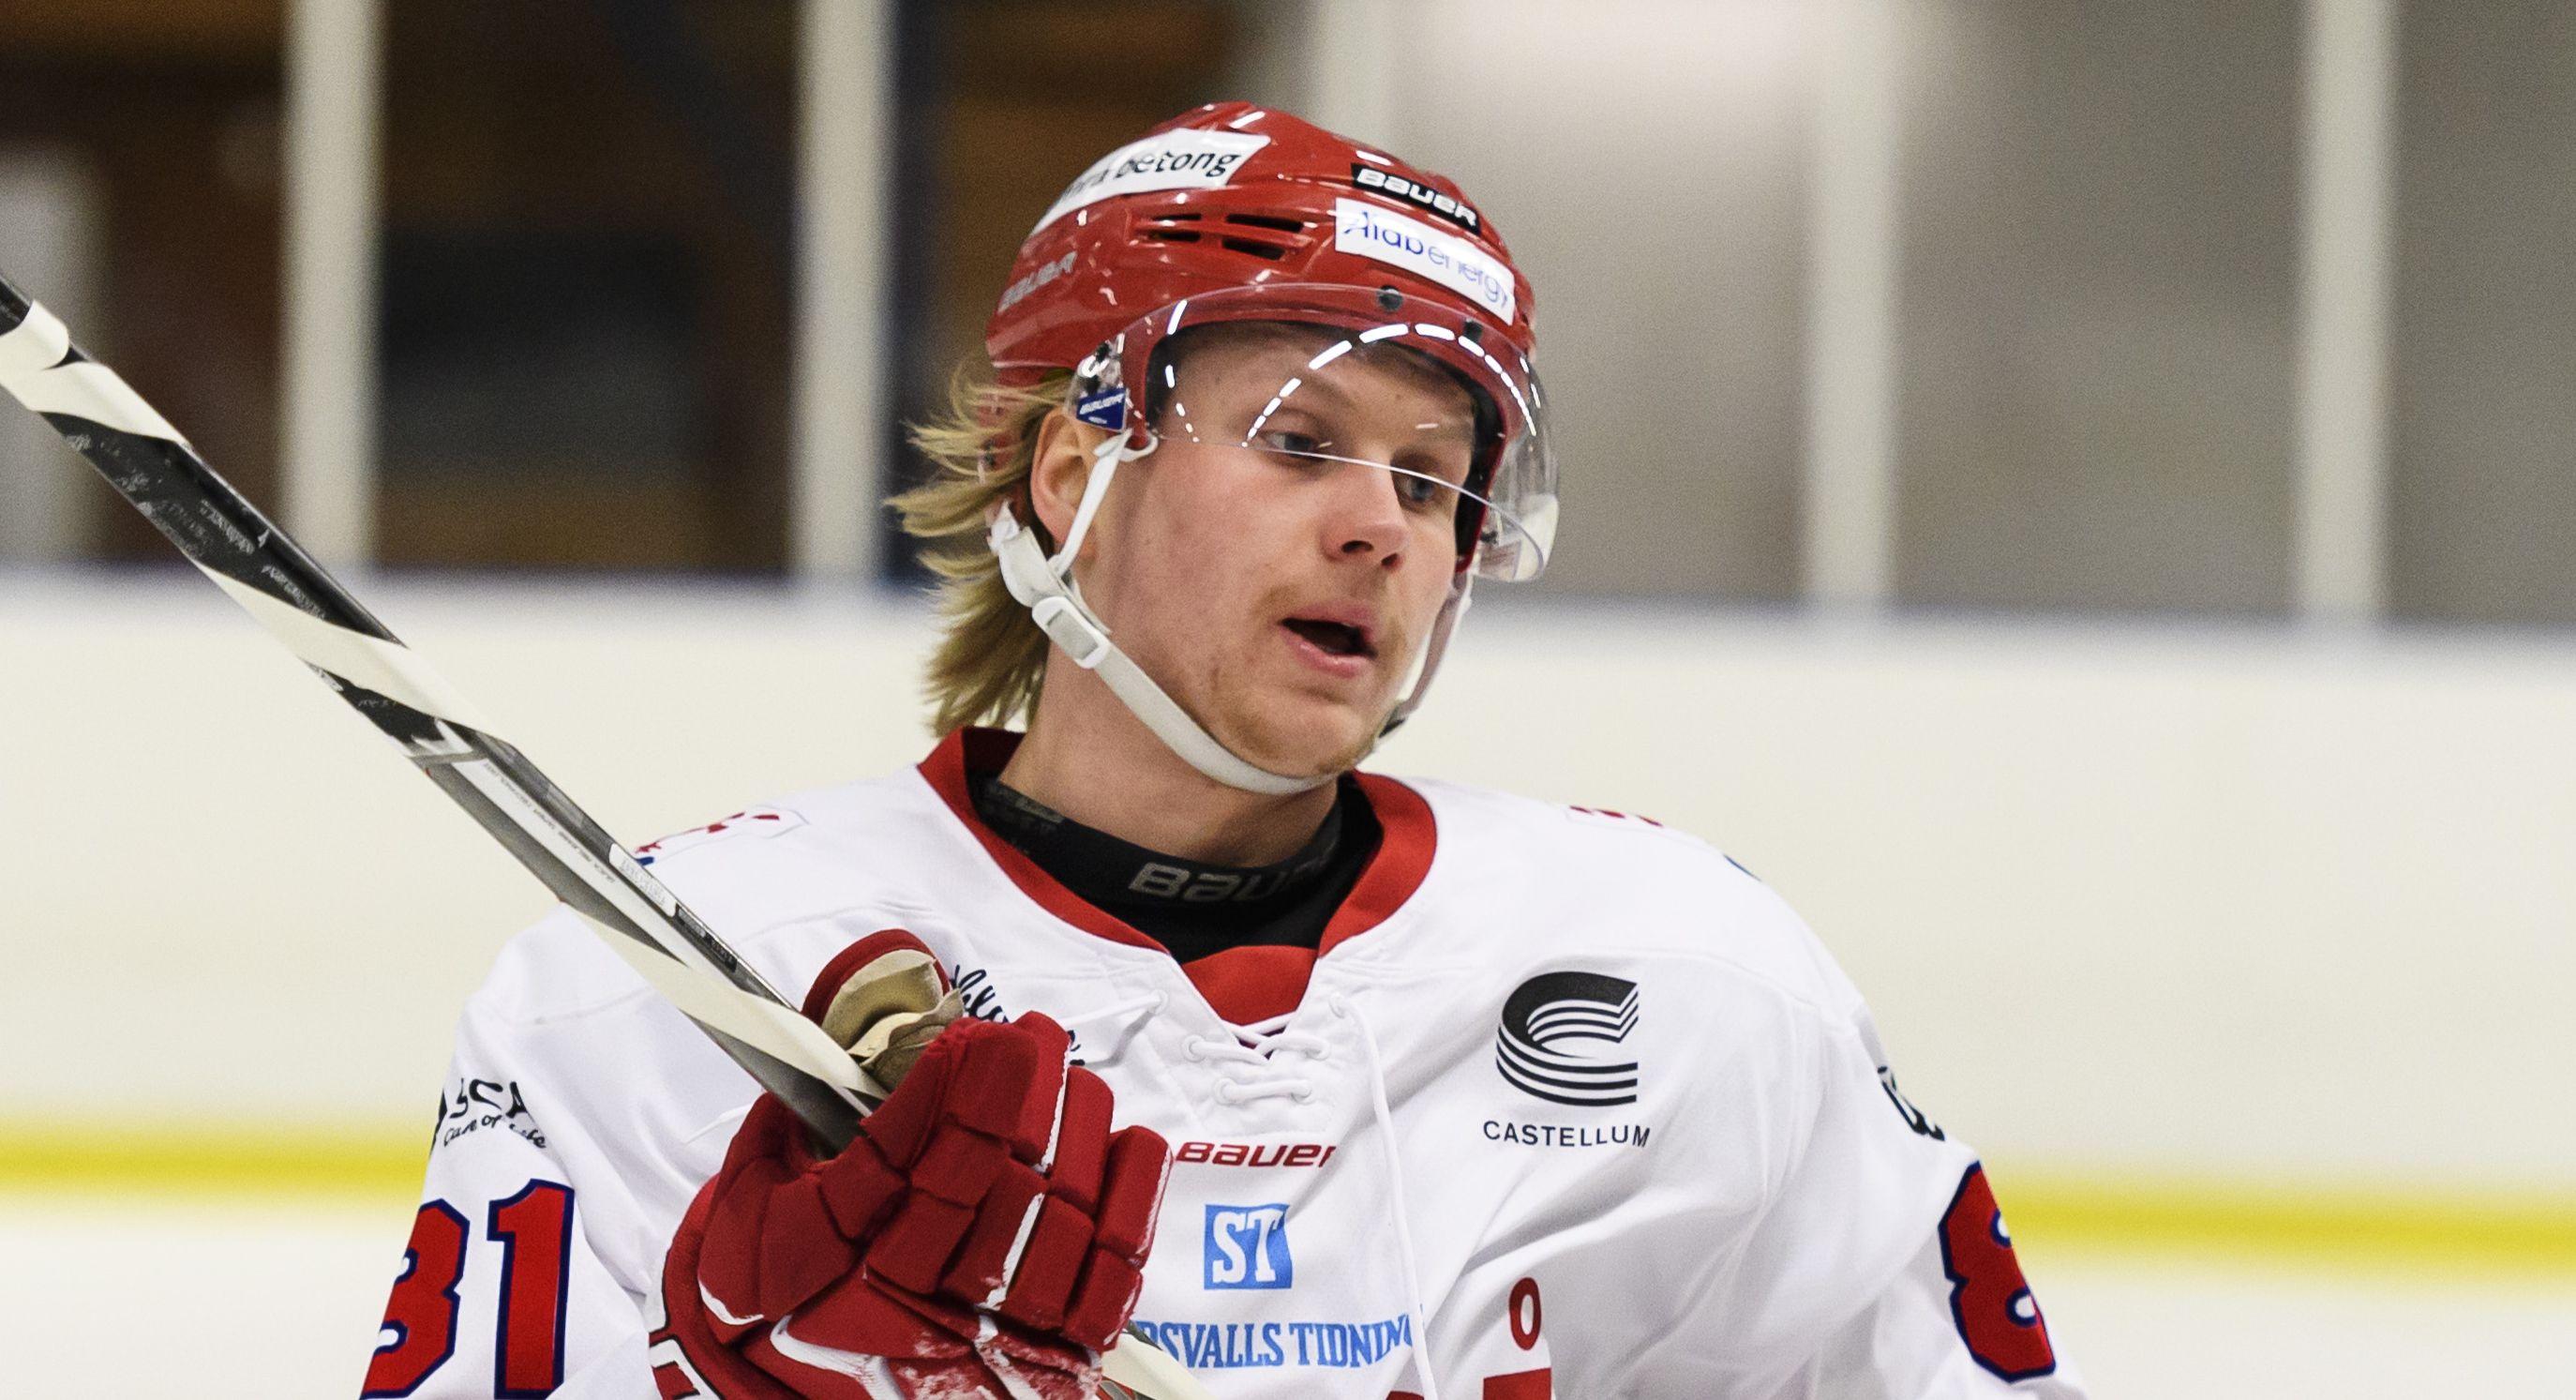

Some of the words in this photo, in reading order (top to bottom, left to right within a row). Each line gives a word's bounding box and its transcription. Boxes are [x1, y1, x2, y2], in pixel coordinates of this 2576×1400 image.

[1130, 854, 1309, 903] BAU
[1484, 1120, 1650, 1148] CASTELLUM
[1212, 1208, 1284, 1284] ST
